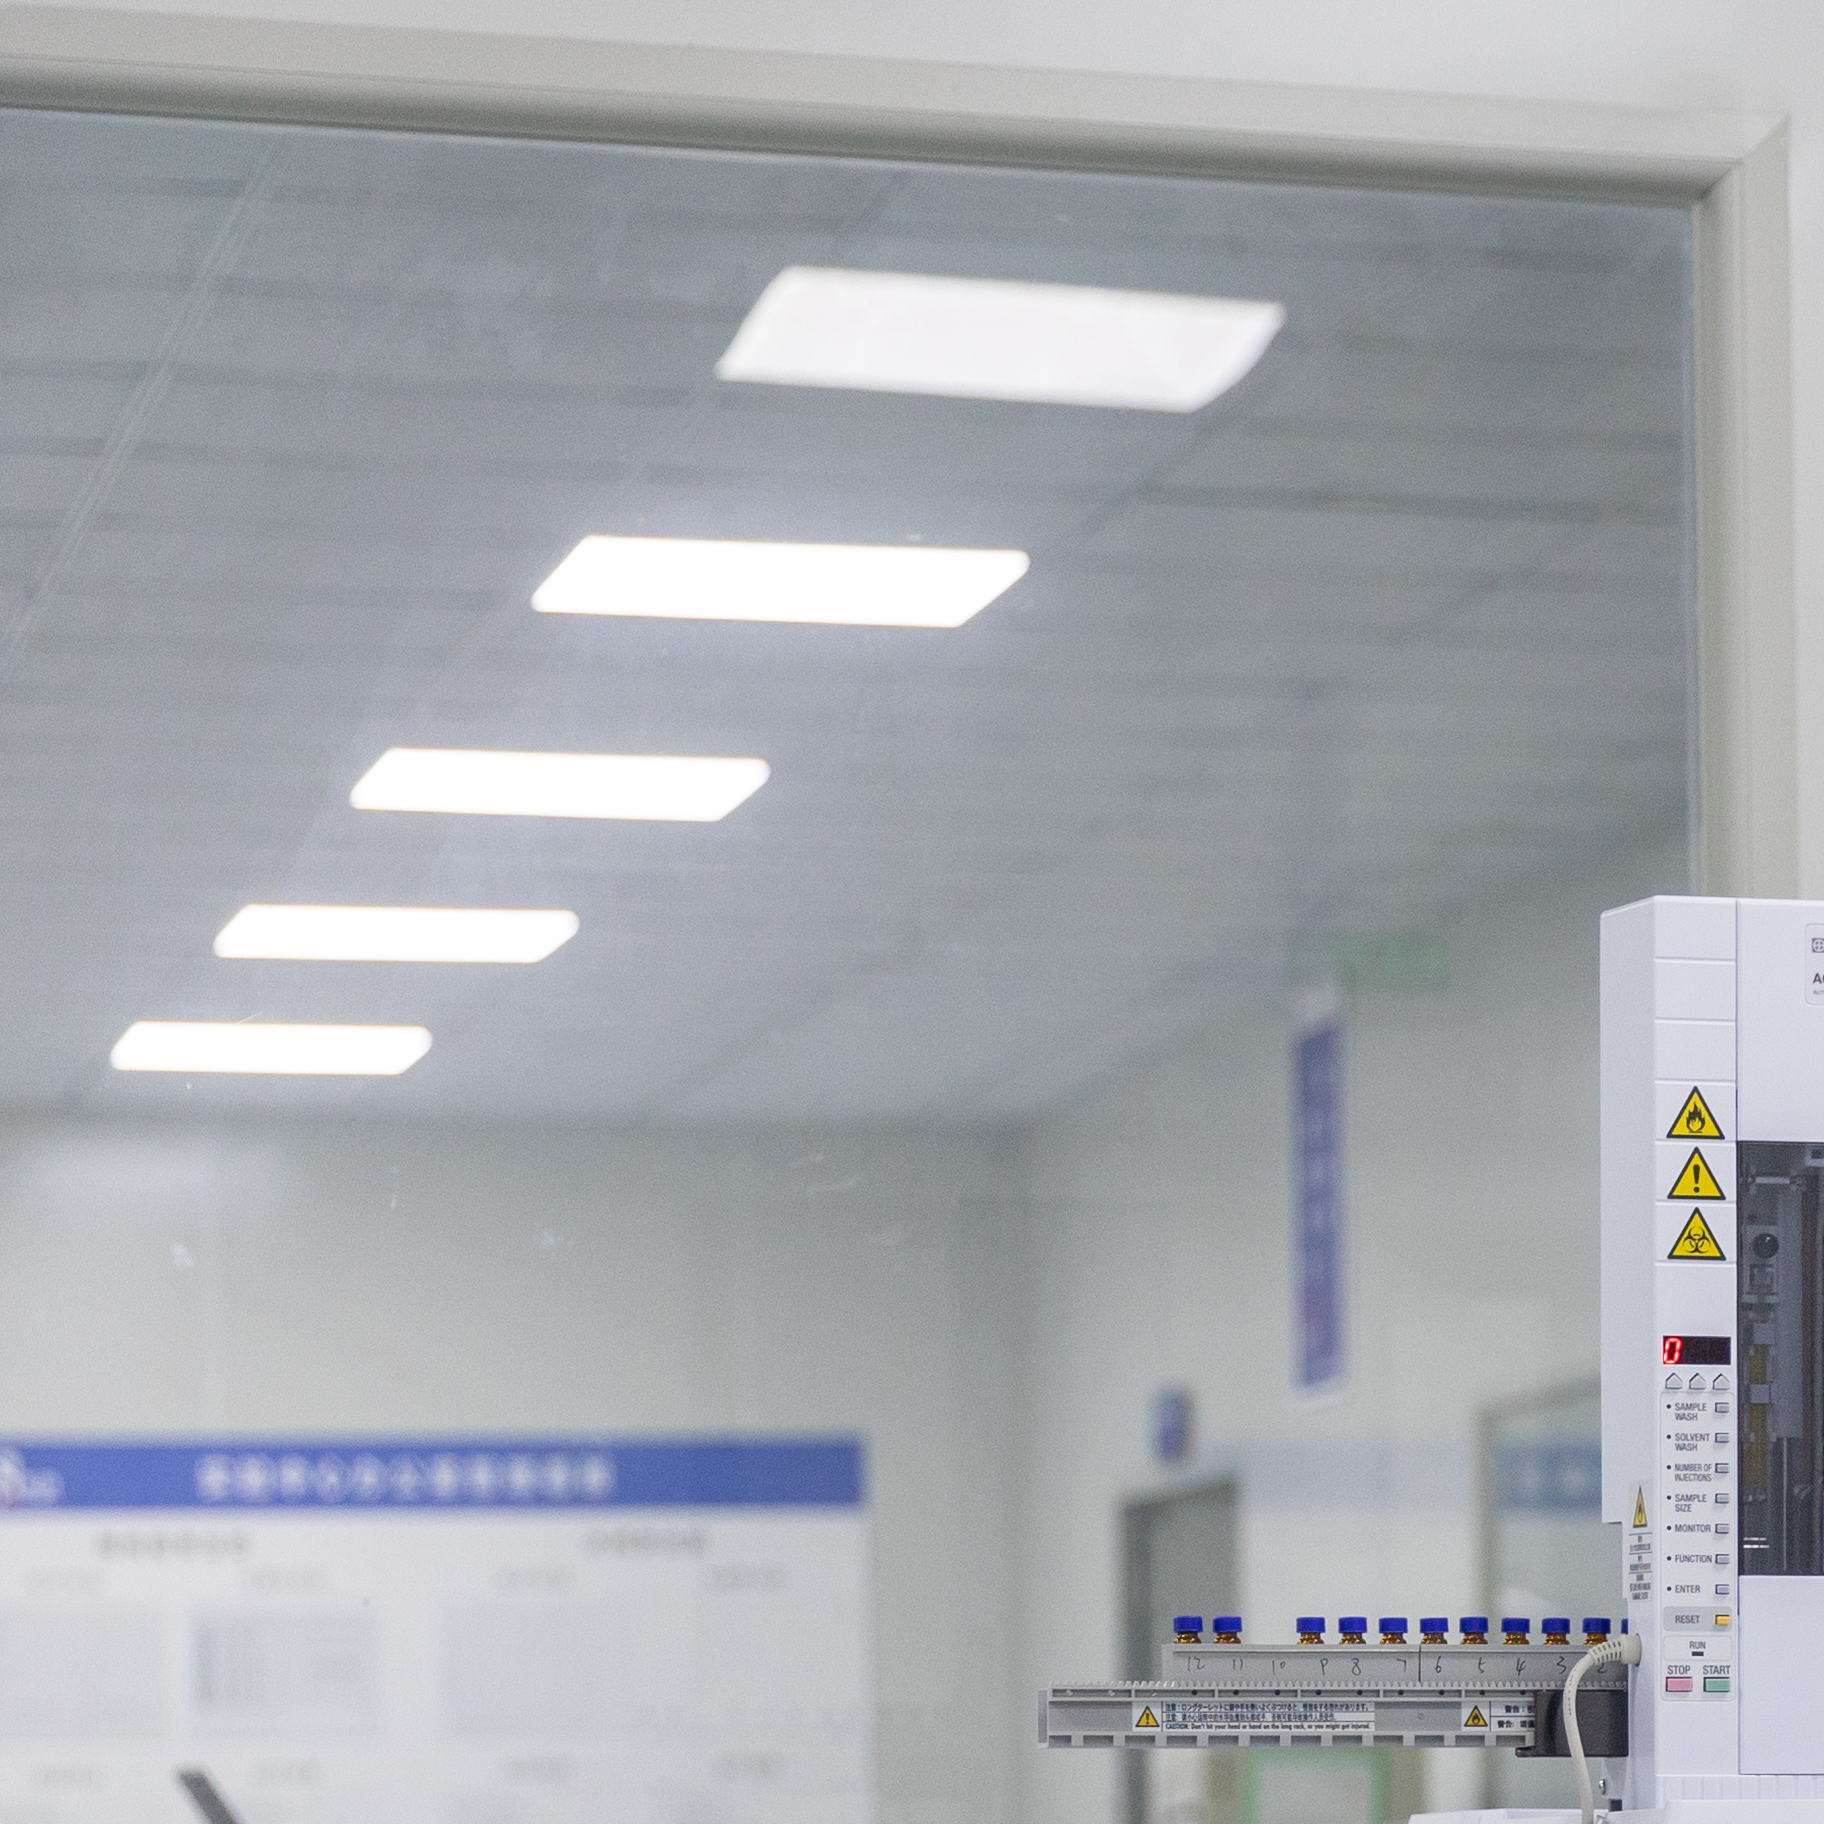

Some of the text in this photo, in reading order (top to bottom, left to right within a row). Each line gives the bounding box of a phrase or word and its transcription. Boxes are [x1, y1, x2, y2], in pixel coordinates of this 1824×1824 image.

[1674, 1403, 1707, 1412] SAMPLE
[1675, 1413, 1698, 1421] WASH
[1675, 1433, 1711, 1442] SOLVENT
[1675, 1443, 1698, 1452] WASH
[1674, 1463, 1712, 1472] NUMBER OF
[1674, 1473, 1713, 1482] INJECTIONS
[1674, 1494, 1707, 1503] SAMPLE
[1674, 1504, 1692, 1512] SIZE
[1674, 1524, 1712, 1532] MONITOR
[1675, 1555, 1713, 1563] FUNCTION
[1674, 1585, 1701, 1593] ENTER
[1675, 1615, 1700, 1624] RESET
[1689, 1641, 1706, 1649] RUN
[1187, 1657, 1205, 1671] 12
[1232, 1658, 1243, 1671] 11
[1272, 1660, 1286, 1674] 10
[1351, 1657, 1361, 1676] 8
[1397, 1658, 1407, 1672] 7
[1434, 1656, 1444, 1673] 6
[1478, 1657, 1487, 1673] 5
[1516, 1657, 1526, 1675] 4
[1556, 1656, 1567, 1674] 3
[1667, 1665, 1730, 1675] STOP START
